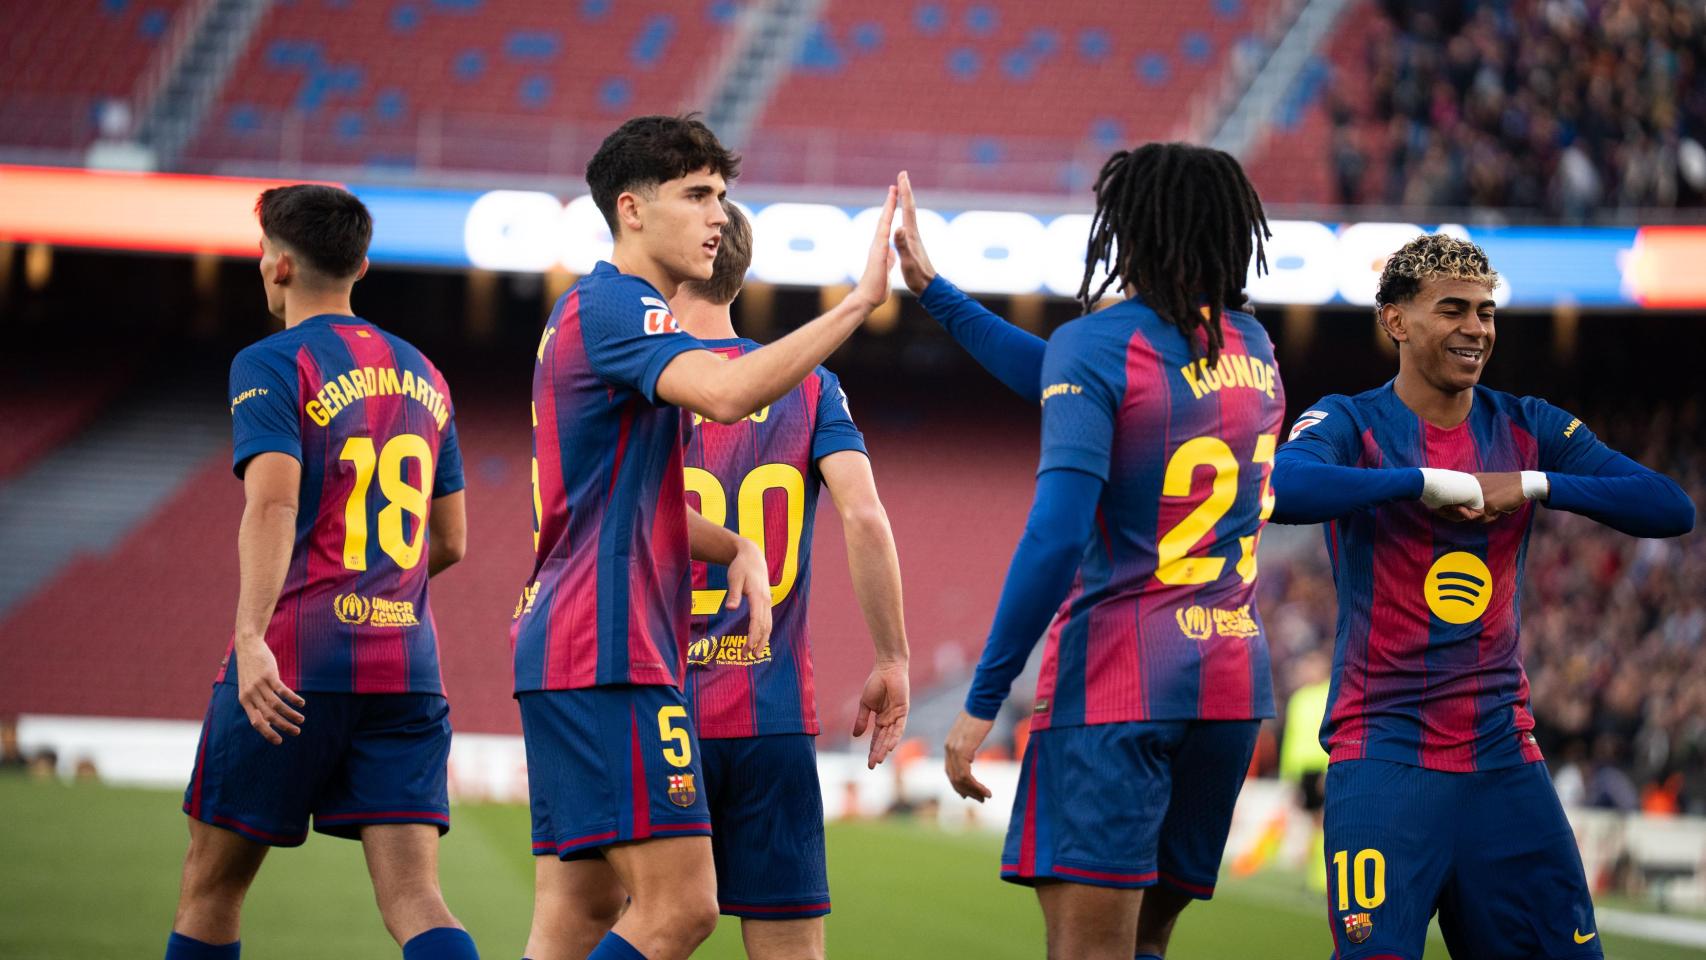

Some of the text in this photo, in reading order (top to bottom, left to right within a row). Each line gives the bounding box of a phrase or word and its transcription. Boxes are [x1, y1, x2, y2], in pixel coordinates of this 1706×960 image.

[339, 433, 433, 571] 18
[372, 597, 413, 614] UNHCR
[658, 705, 691, 768] 5
[1333, 848, 1386, 911] 10
